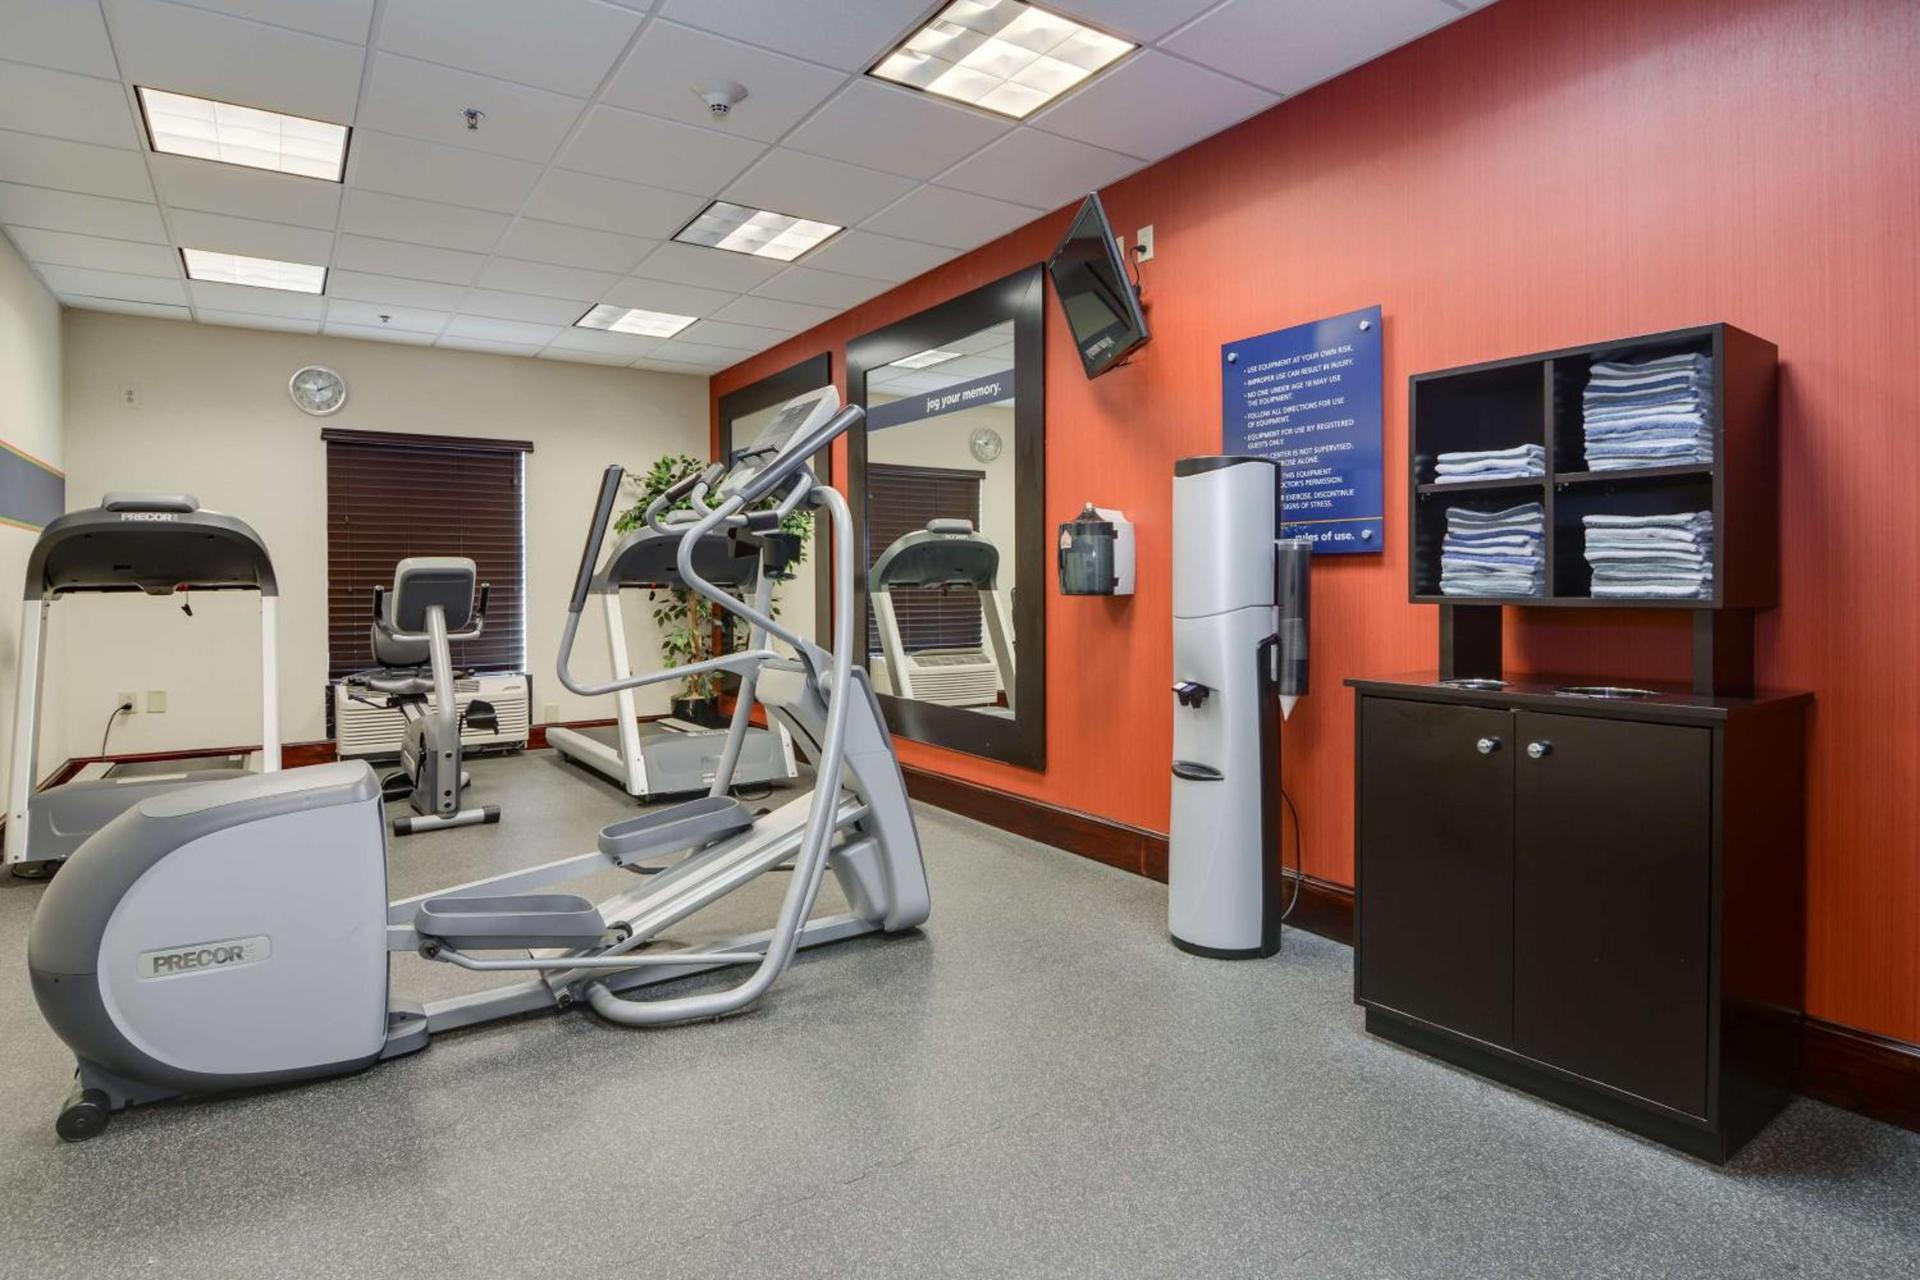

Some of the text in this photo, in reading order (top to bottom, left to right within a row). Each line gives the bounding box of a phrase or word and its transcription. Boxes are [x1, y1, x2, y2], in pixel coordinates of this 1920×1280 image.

[1248, 366, 1257, 374] USE
[1259, 358, 1291, 372] EQUIPMENT
[1301, 352, 1319, 362] YOUR
[1321, 348, 1336, 358] OWN
[1248, 375, 1274, 386] IMPROPER
[1287, 370, 1300, 378] CAN
[1301, 364, 1322, 376] RESULT
[1257, 388, 1268, 396] ONE
[1271, 385, 1290, 394] UNDER
[1313, 379, 1327, 387] MAY
[1330, 375, 1341, 383] USE
[926, 382, 1002, 413] jog your memory.
[1248, 399, 1258, 407] THE
[1248, 397, 1345, 420] FOLLOW ALL DIRECTIONS FOR USE
[1248, 419, 1354, 441] EQUIPMENT FOR USE BY REGISTERED
[1248, 440, 1268, 449] GUESTS
[1270, 449, 1292, 459] CENTER
[1300, 447, 1312, 455] NOT
[1296, 468, 1331, 478] EQUIPMENT
[1313, 488, 1355, 498] DISCONTINUE
[1282, 502, 1300, 510] SIGNS
[1301, 501, 1309, 509] OF
[121, 512, 173, 521] PRECOR
[1320, 529, 1333, 541] of
[1334, 532, 1356, 541] use.
[153, 945, 245, 974] PRECOR
